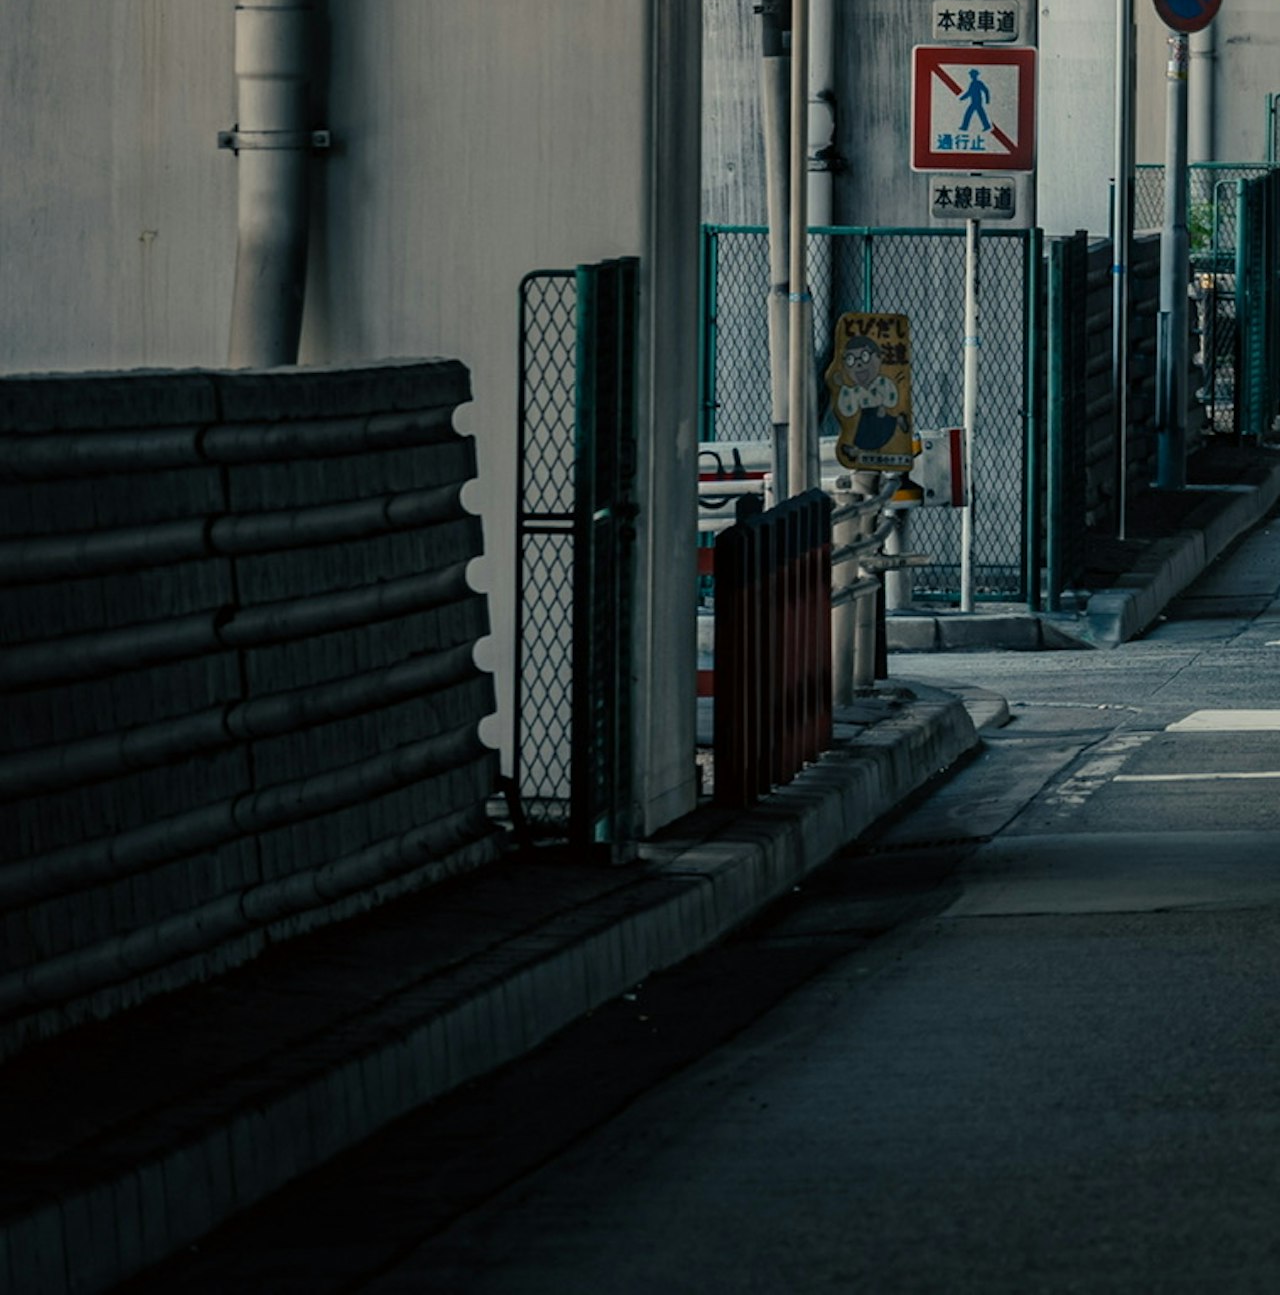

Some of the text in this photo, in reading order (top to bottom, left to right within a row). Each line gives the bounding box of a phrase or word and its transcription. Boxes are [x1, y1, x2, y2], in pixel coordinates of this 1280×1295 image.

[938, 9, 1015, 32] 本線車道
[937, 134, 985, 151] 通行止
[934, 186, 1012, 210] 本線車道
